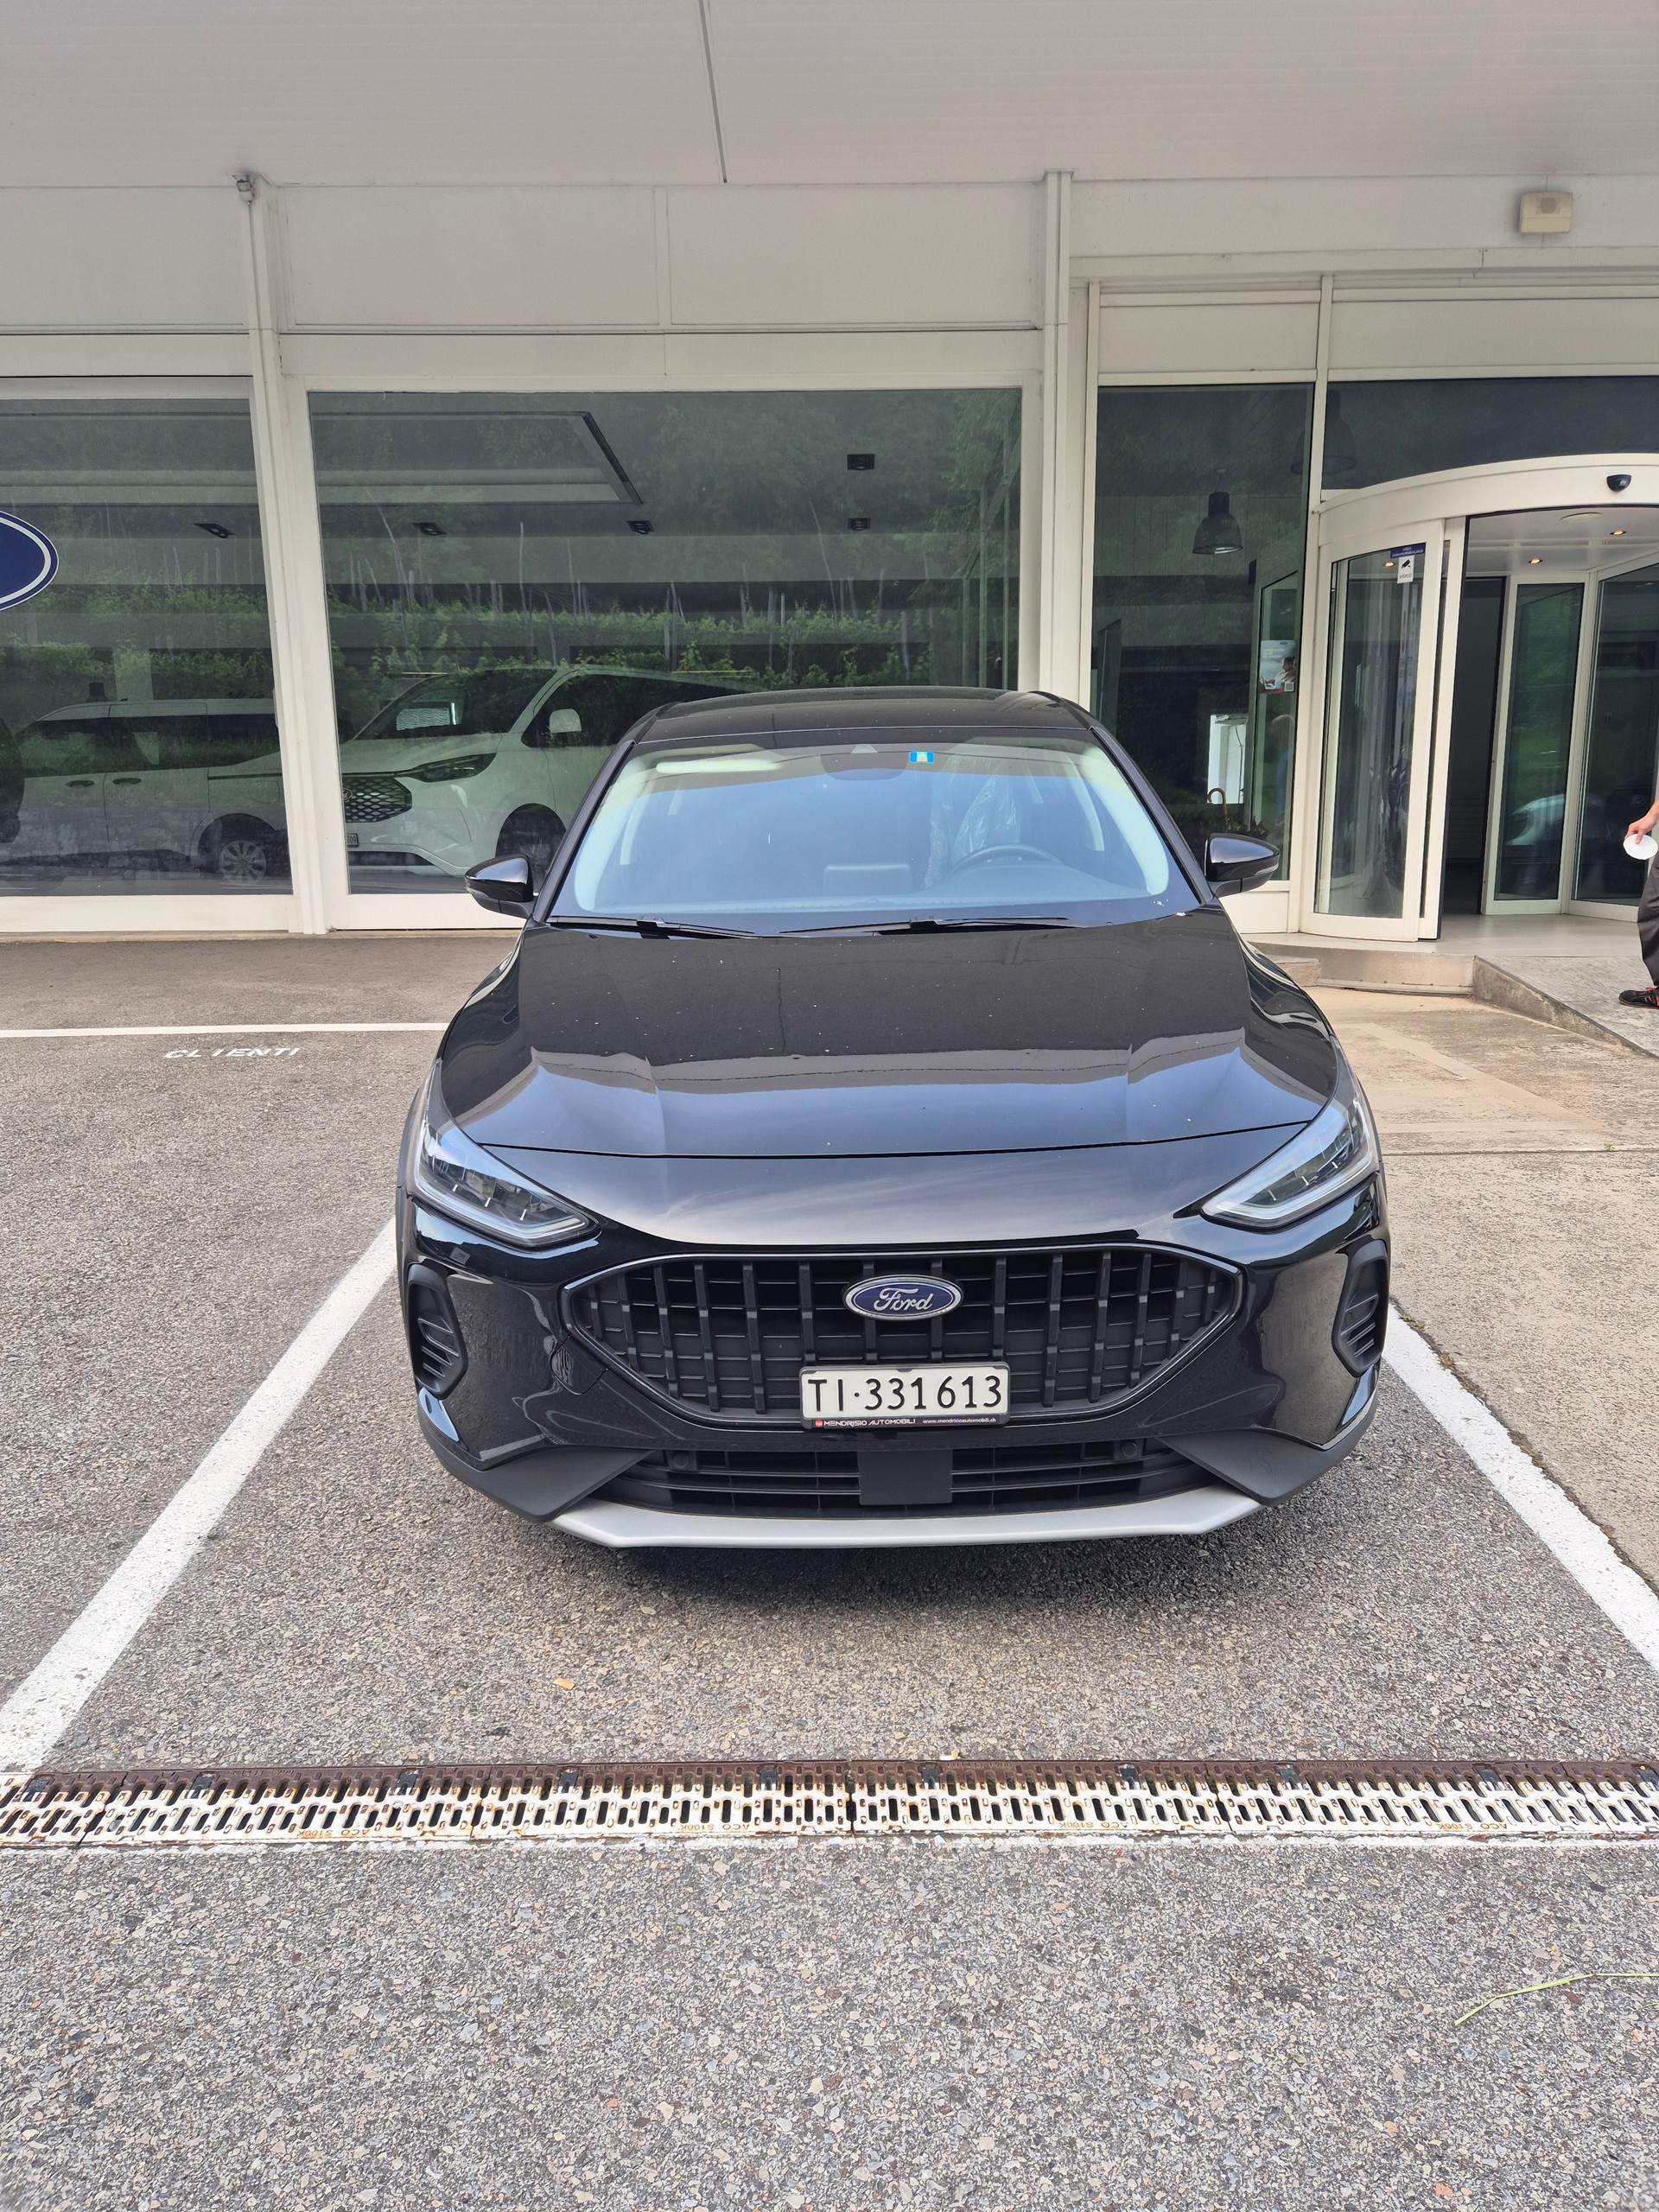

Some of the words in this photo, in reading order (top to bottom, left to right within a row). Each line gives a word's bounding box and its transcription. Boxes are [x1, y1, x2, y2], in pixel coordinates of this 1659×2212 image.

[165, 1047, 300, 1058] CLIENTI
[873, 1287, 933, 1311] Ford
[296, 1828, 334, 1837] S100K
